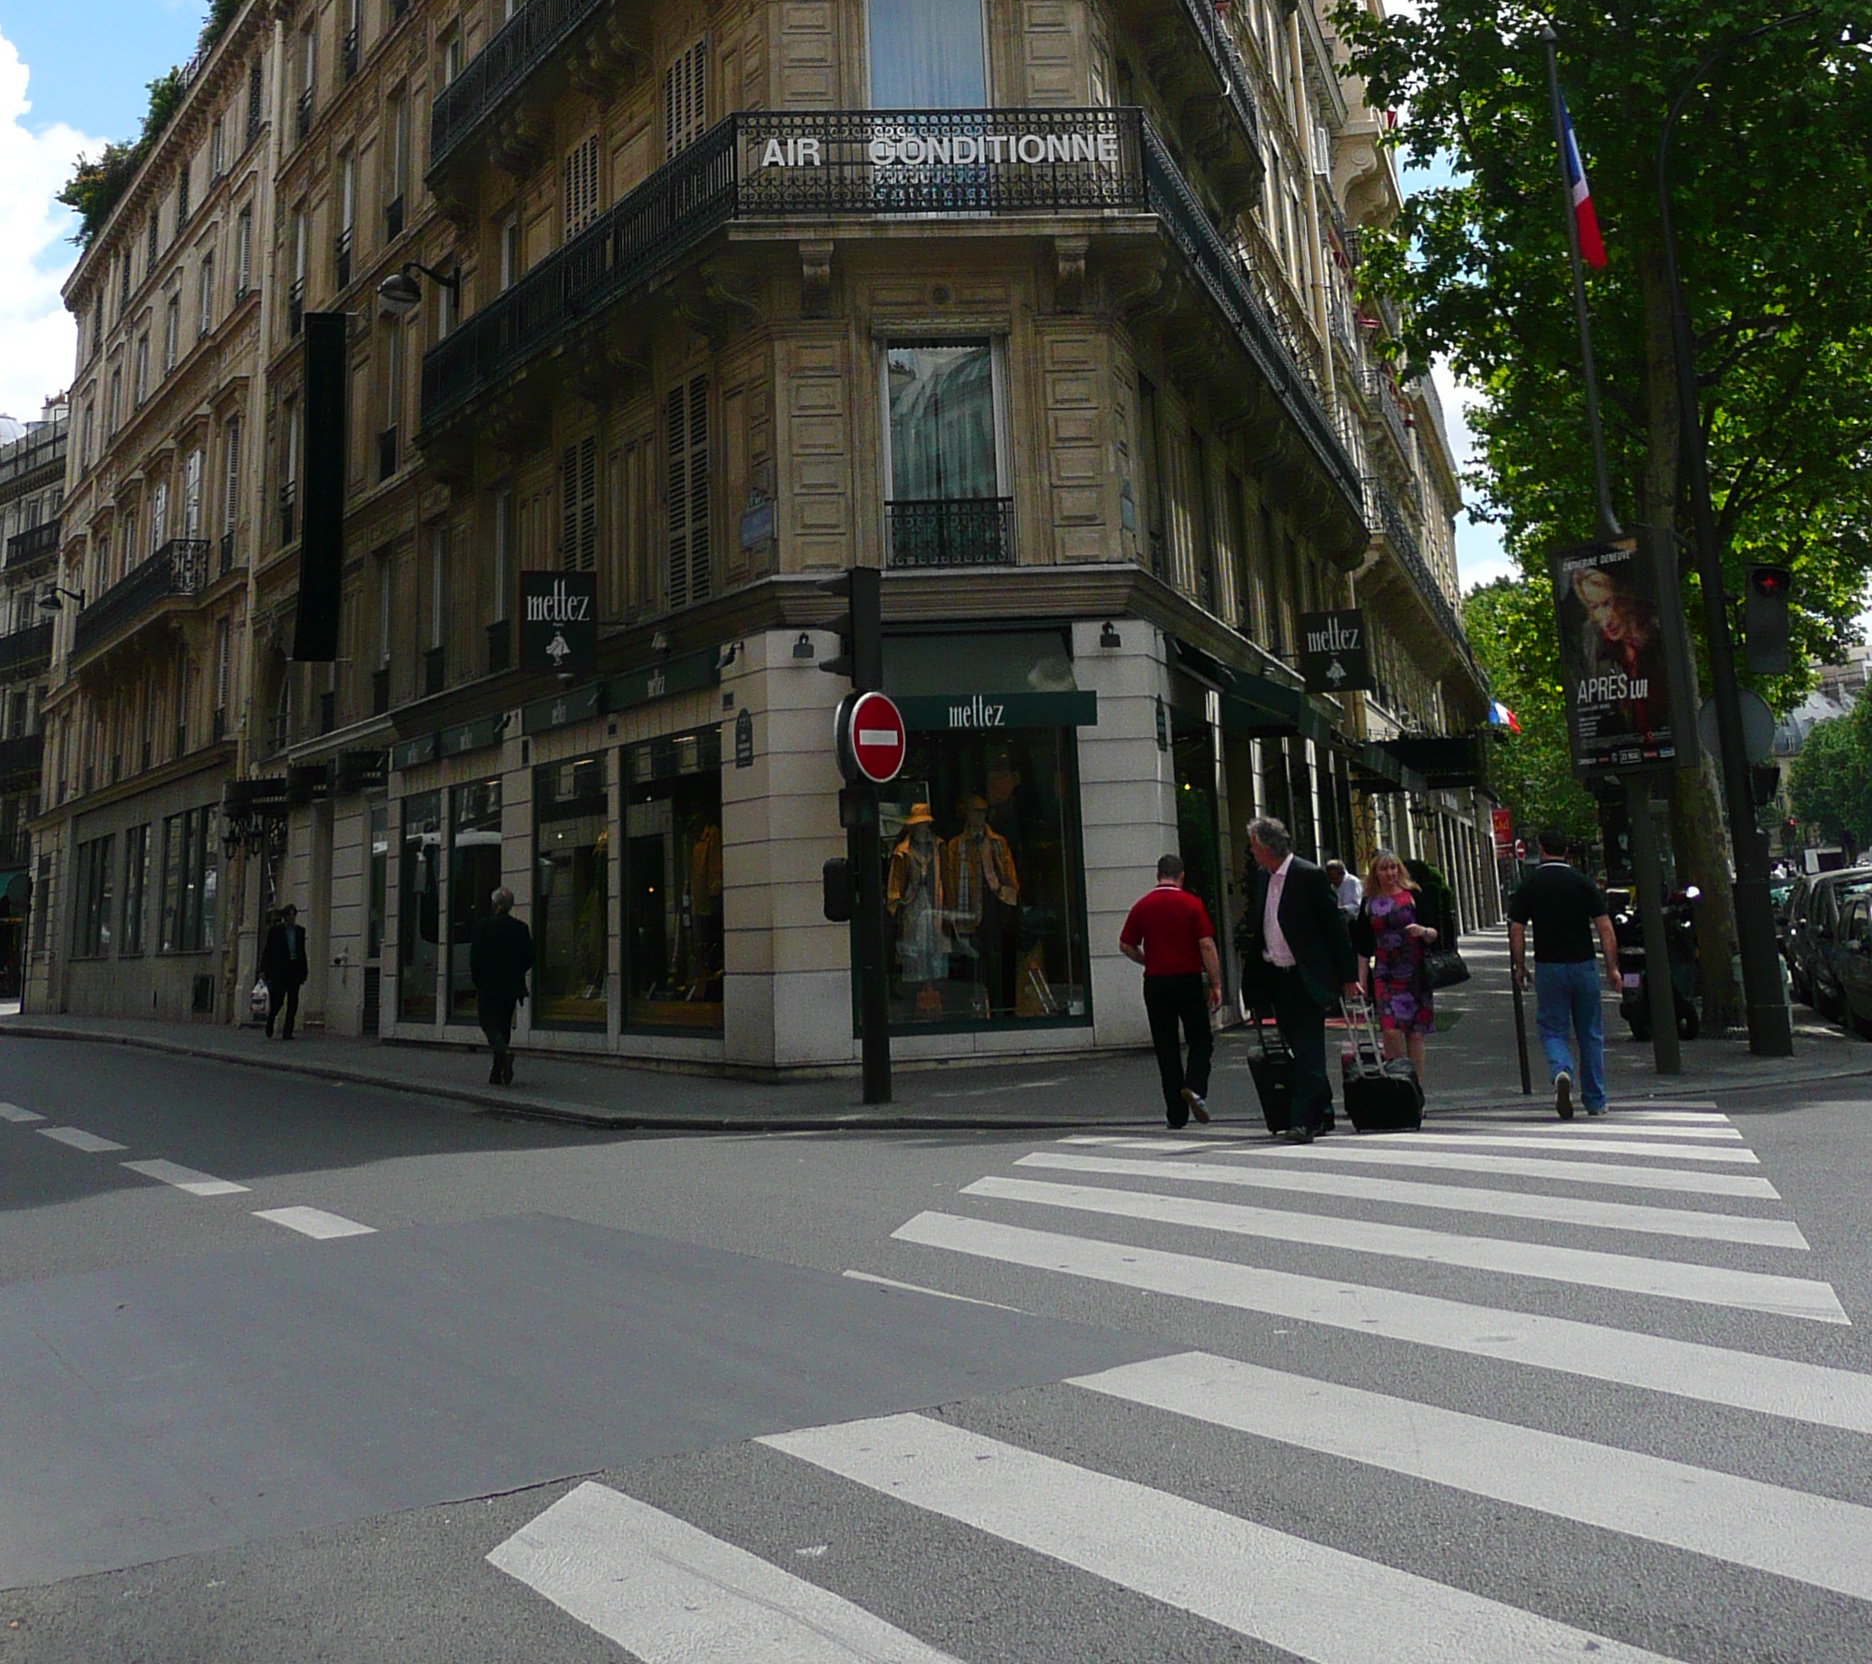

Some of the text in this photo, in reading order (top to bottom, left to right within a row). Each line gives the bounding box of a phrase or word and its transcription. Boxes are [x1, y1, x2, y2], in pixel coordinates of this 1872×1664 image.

[762, 137, 821, 167] AIR
[526, 579, 590, 621] mettez
[1307, 617, 1361, 653] mettez
[1577, 668, 1648, 704] APRÈS LUI
[948, 694, 1005, 728] mettez
